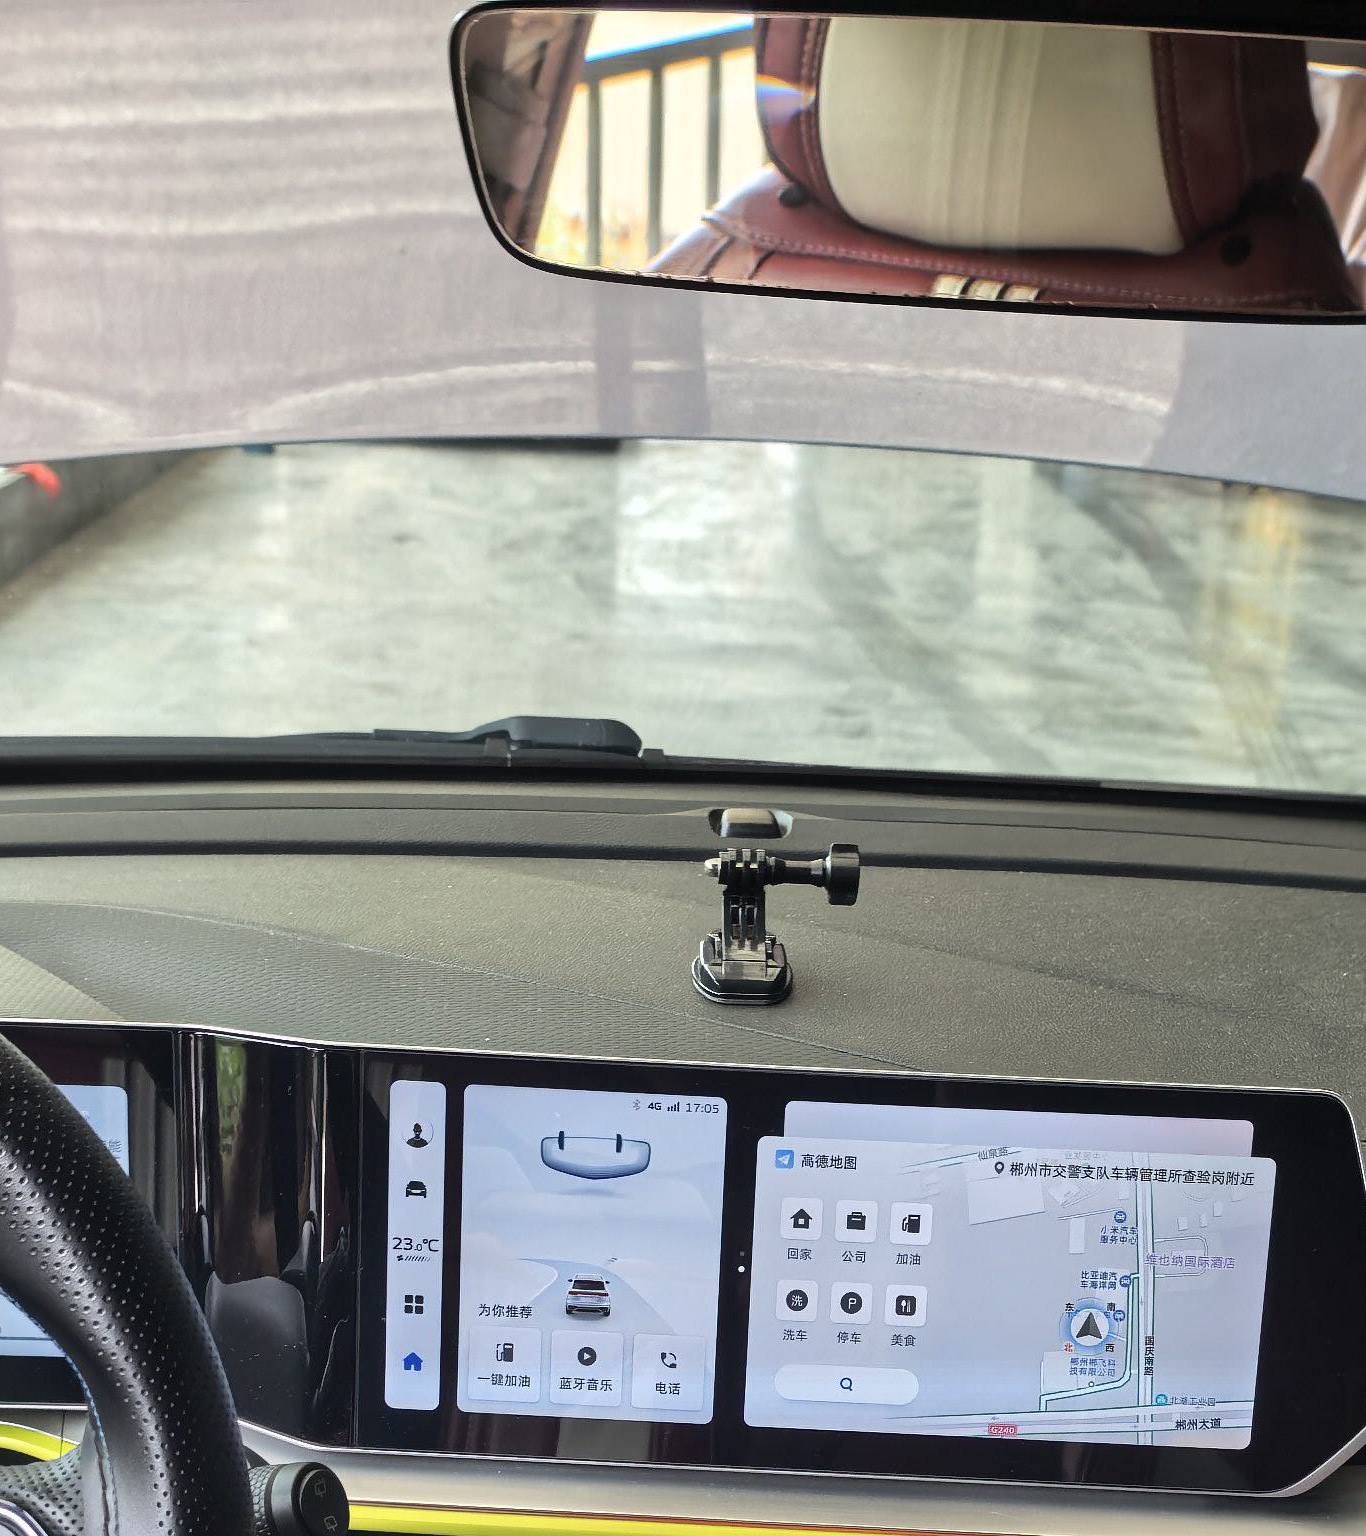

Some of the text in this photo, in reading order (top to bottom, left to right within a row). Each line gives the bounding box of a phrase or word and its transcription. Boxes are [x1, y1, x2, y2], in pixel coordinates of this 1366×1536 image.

[647, 1101, 662, 1112] 4G
[685, 1102, 720, 1114] 17:05
[800, 1153, 858, 1170] 高德地图
[1009, 1161, 1256, 1187] 郴州市交警支队车辆管理所查验岗附近
[787, 1247, 813, 1261] 回家
[841, 1250, 867, 1264] 公司
[895, 1253, 922, 1266] 加油
[478, 1303, 533, 1319] 为你推荐
[782, 1328, 808, 1342] 洗车
[837, 1331, 863, 1345] 停车
[890, 1334, 917, 1347] 美食
[477, 1373, 532, 1388] 一键加油
[558, 1376, 614, 1392] 蓝牙音乐
[654, 1382, 682, 1396] 电话
[1174, 1417, 1222, 1431] 郴州大道
